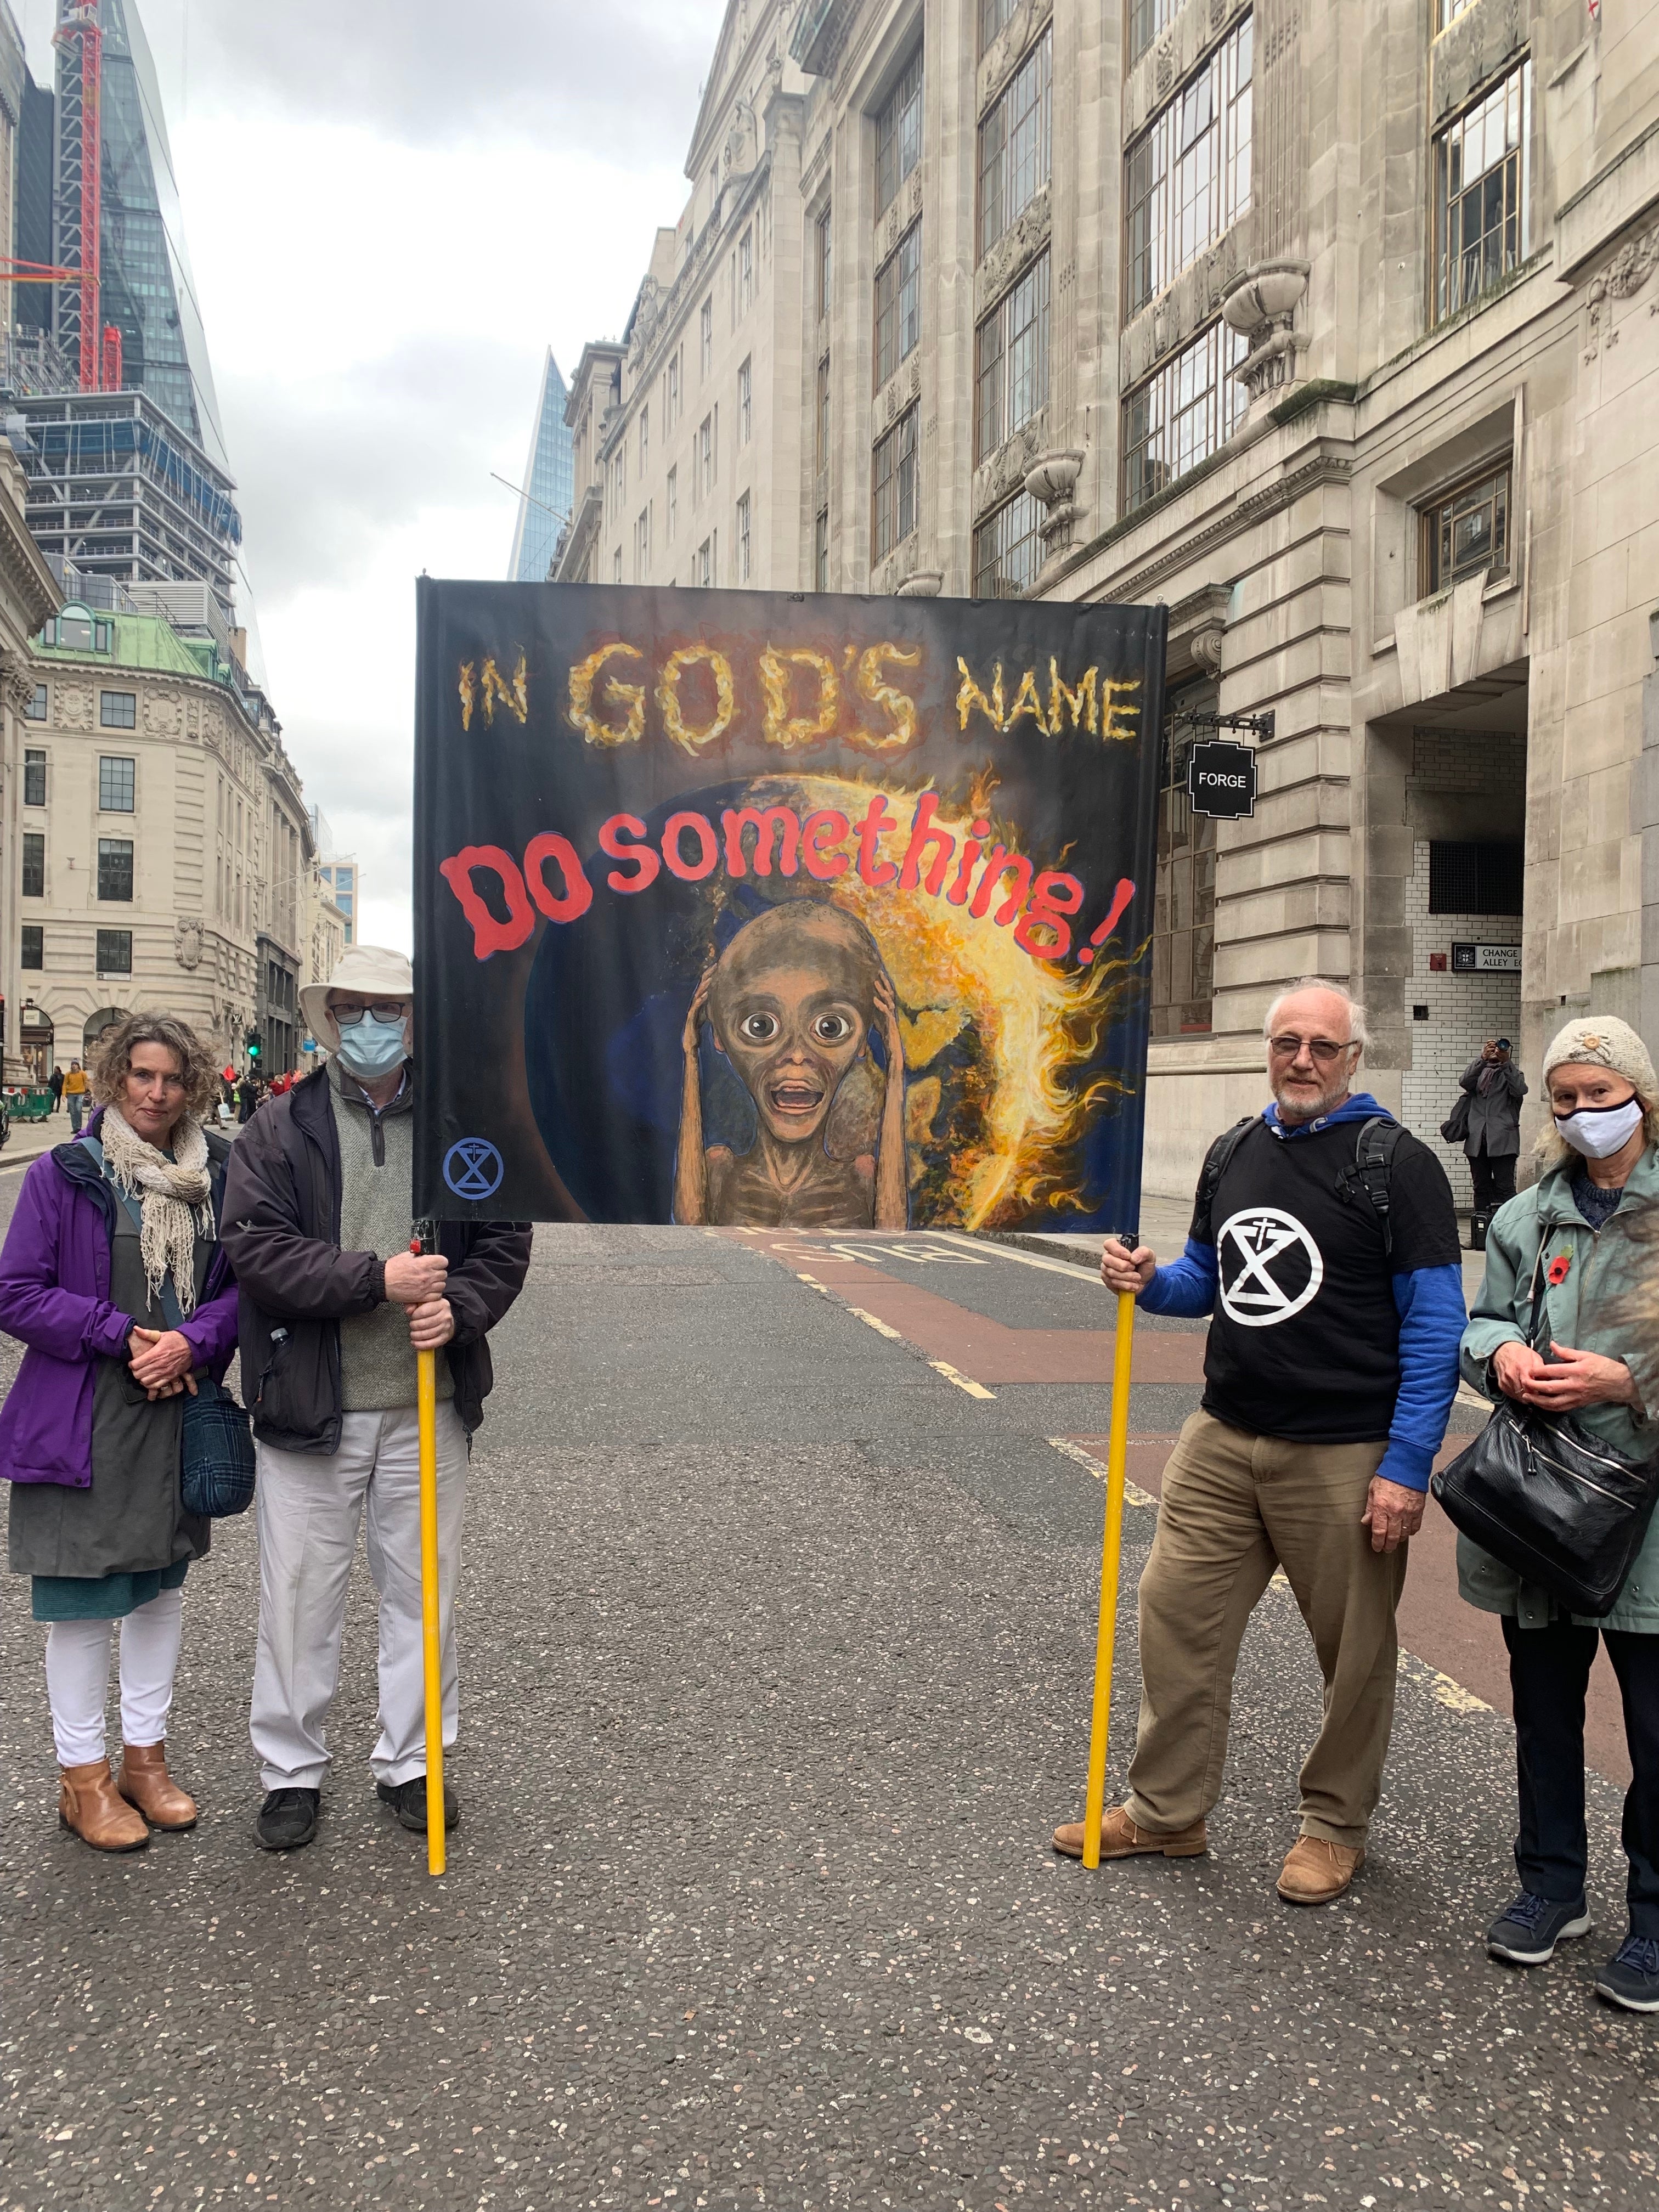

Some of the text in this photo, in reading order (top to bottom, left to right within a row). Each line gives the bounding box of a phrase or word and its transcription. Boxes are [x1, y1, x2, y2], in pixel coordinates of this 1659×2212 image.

[459, 642, 1142, 755] IN GOD'S NAME
[1199, 772, 1246, 788] FORGE
[1482, 949, 1517, 957] CHANGE
[770, 1243, 991, 1264] BUS
